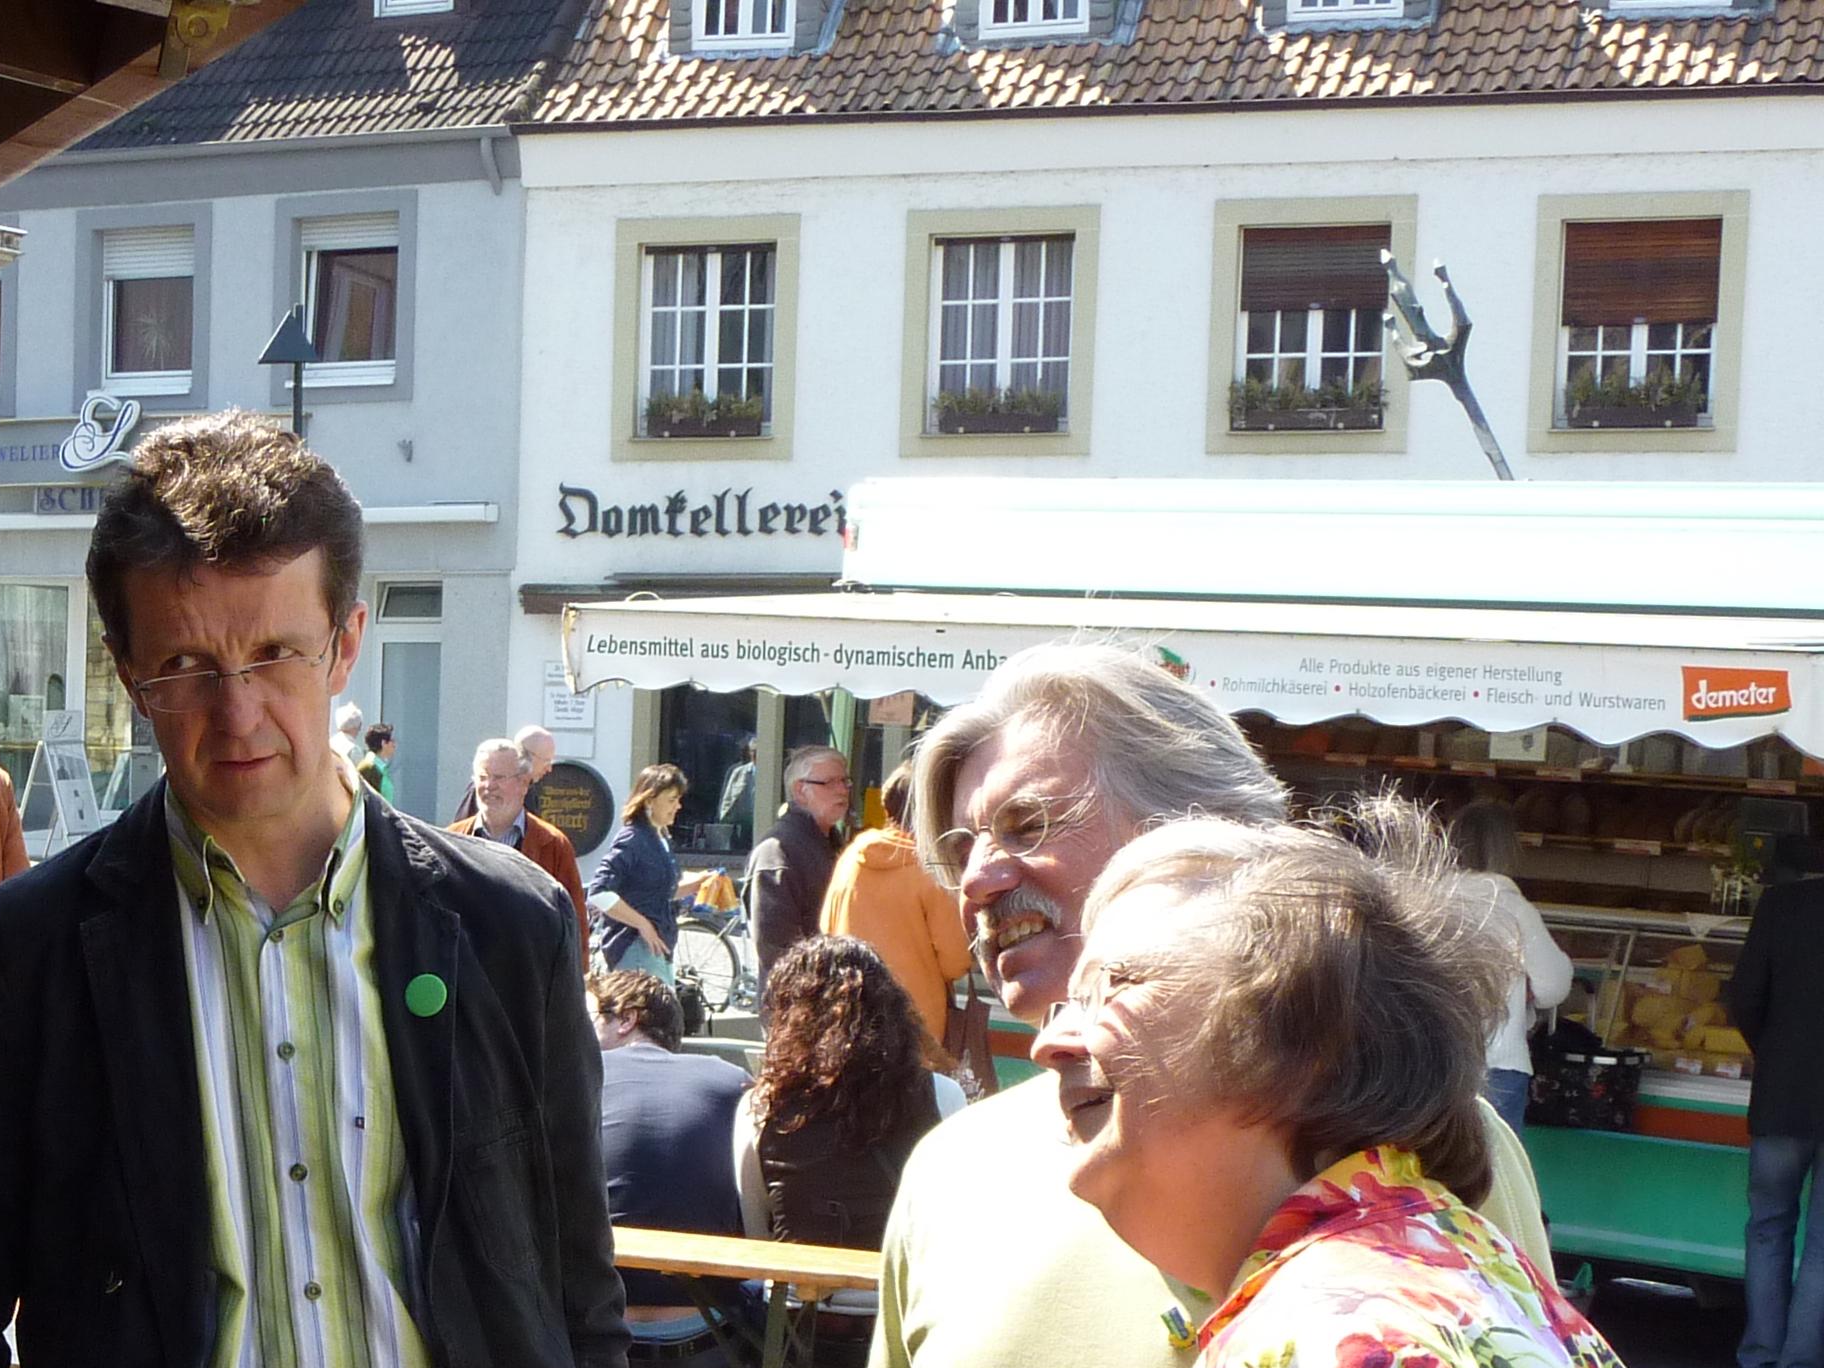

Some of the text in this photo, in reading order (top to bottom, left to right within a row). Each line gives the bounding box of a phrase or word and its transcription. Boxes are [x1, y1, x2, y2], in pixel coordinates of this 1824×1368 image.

[555, 482, 848, 538] Domkellerei
[586, 634, 695, 658] Lebensmittel
[701, 643, 730, 660] aus
[961, 648, 1008, 671] Anba
[1298, 657, 1563, 687] Alle Produkte aus eigener Herstellung
[1222, 676, 1328, 696] Rohmilchkäserei
[1348, 682, 1467, 702] Holzofenbäckerei
[1544, 690, 1573, 707] und
[1578, 691, 1666, 711] Wurstwaren
[1691, 679, 1777, 710] demeter
